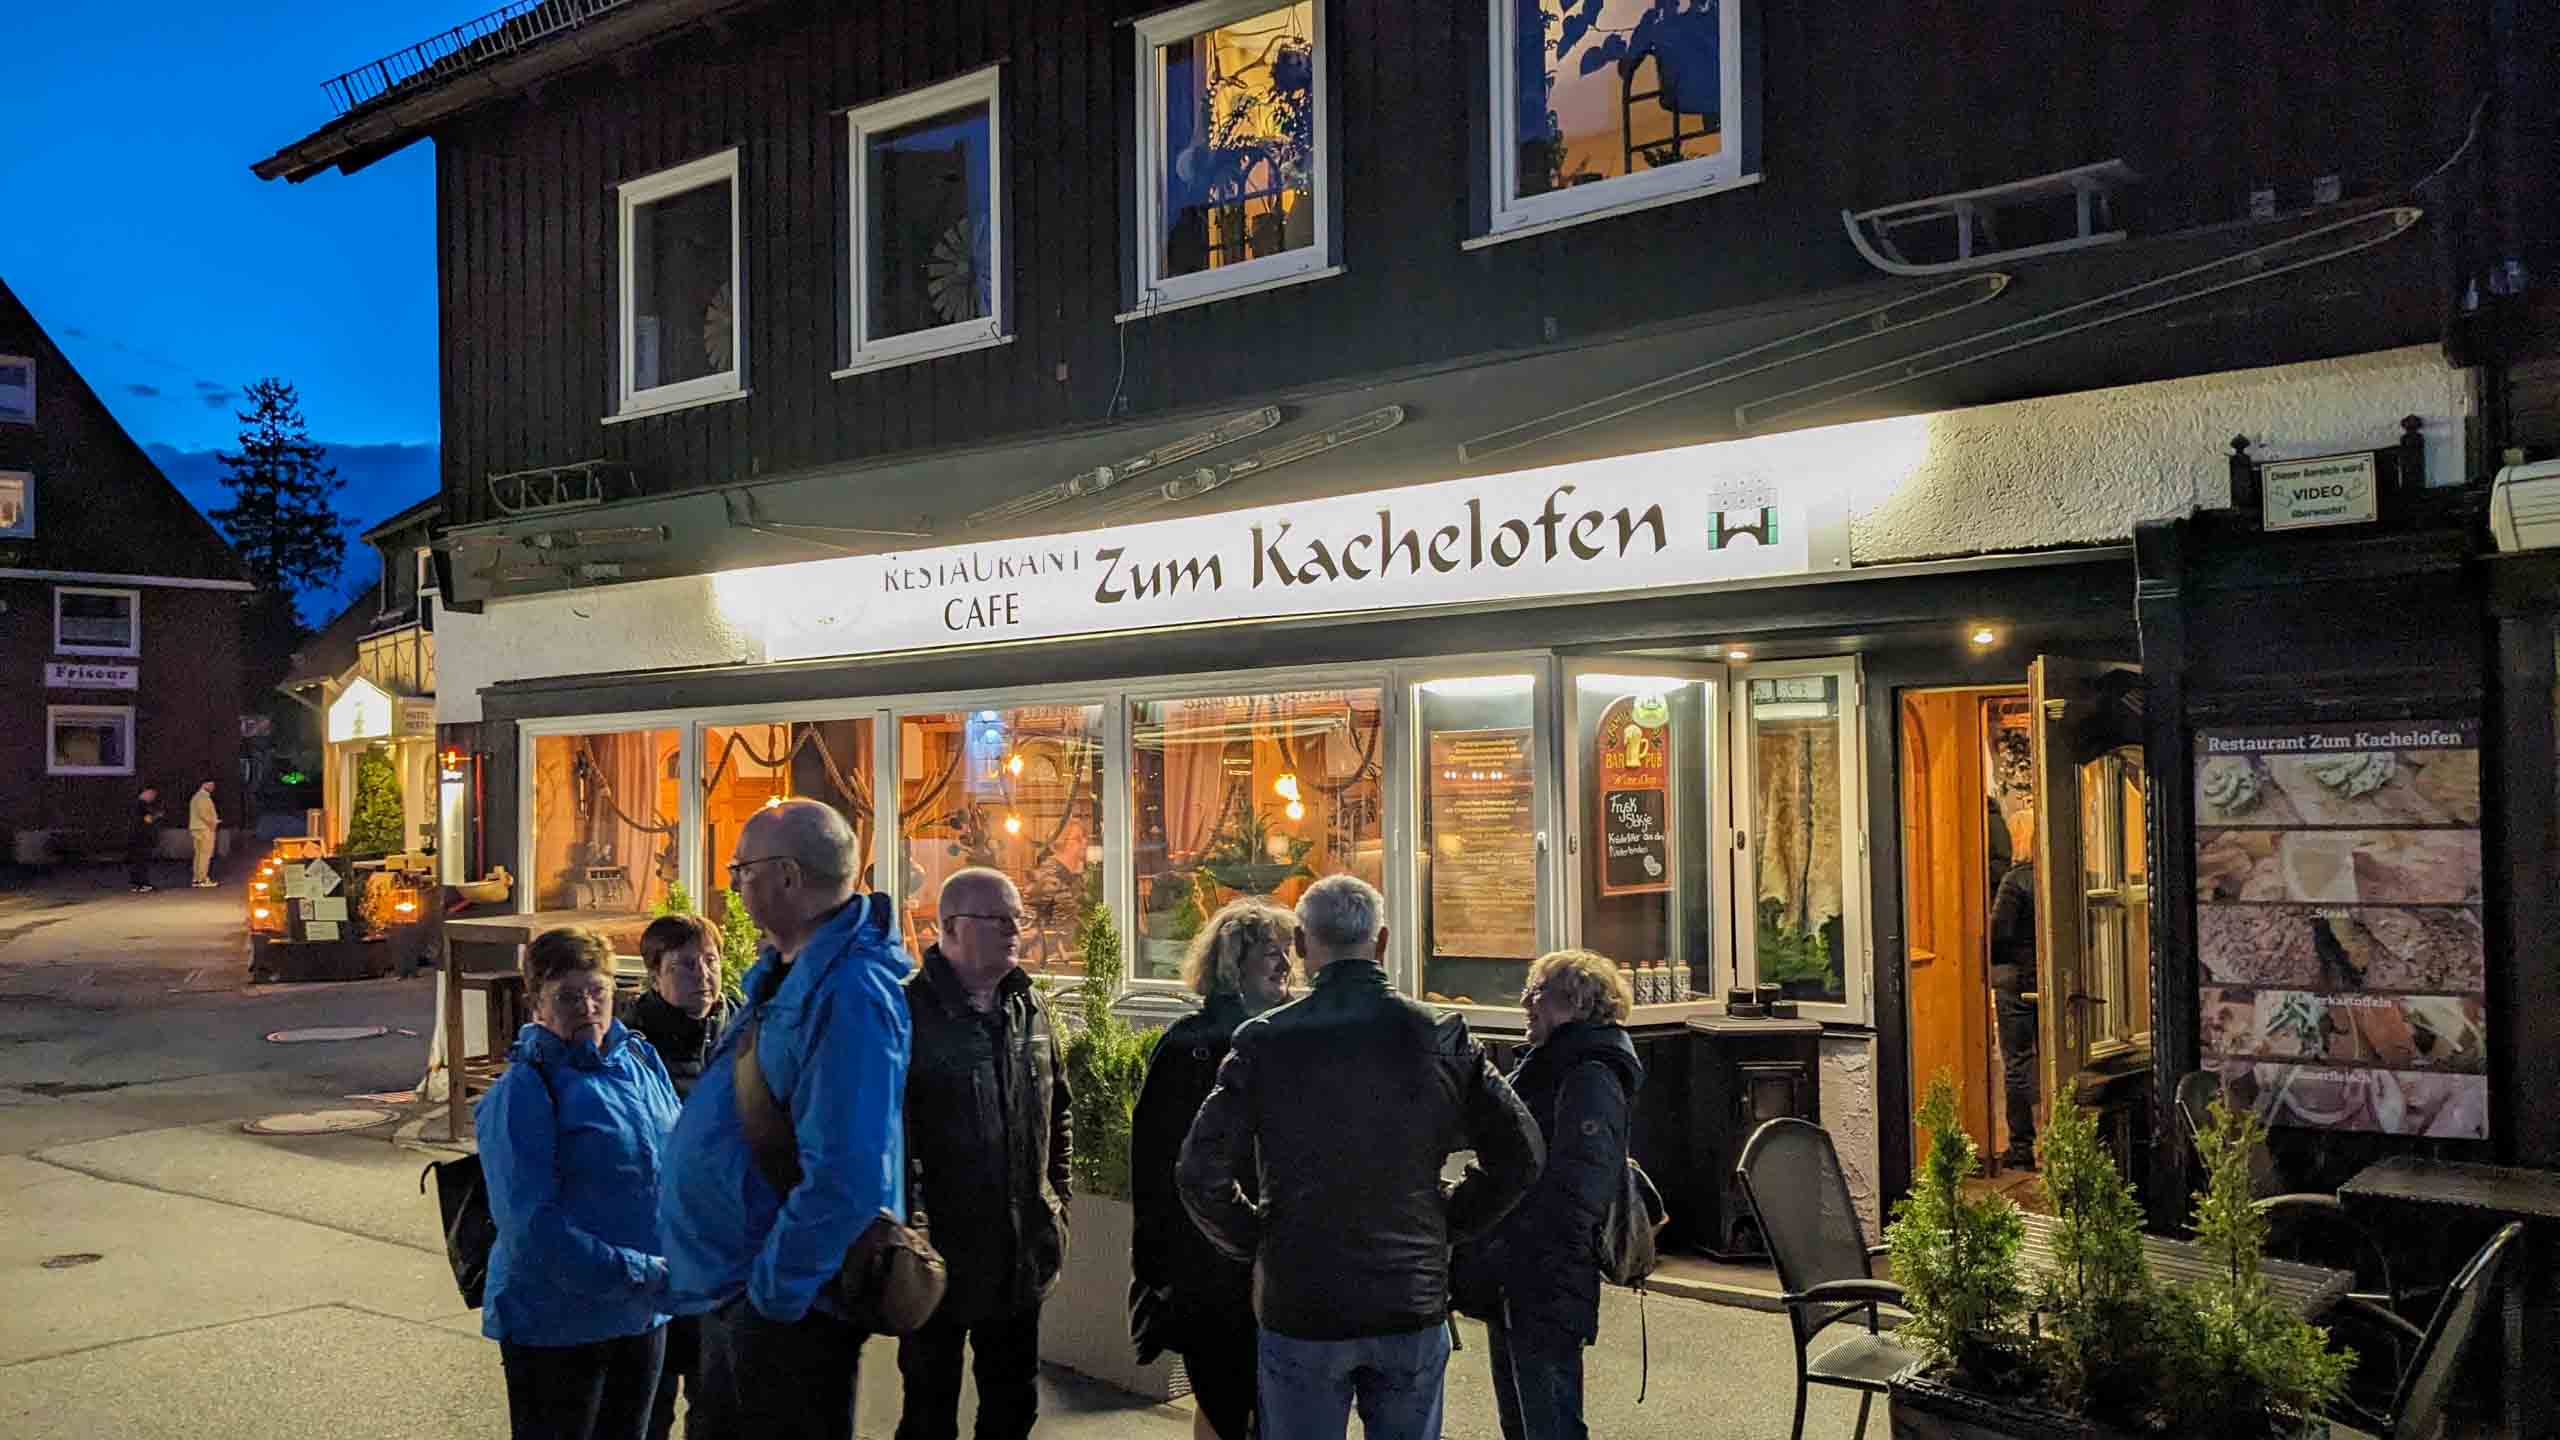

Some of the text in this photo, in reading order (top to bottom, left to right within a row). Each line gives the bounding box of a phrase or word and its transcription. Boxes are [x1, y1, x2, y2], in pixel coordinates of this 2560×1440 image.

[2292, 485, 2344, 500] VIDEO
[1095, 484, 1668, 604] Zum Kachelofen
[884, 547, 1080, 592] RESTAURANT
[943, 592, 1020, 631] CAFE
[56, 665, 129, 679] Friseur
[2208, 730, 2462, 752] Restaurant Zum Kachelofen
[1605, 752, 1626, 769] BAR
[1646, 751, 1663, 769] PUB
